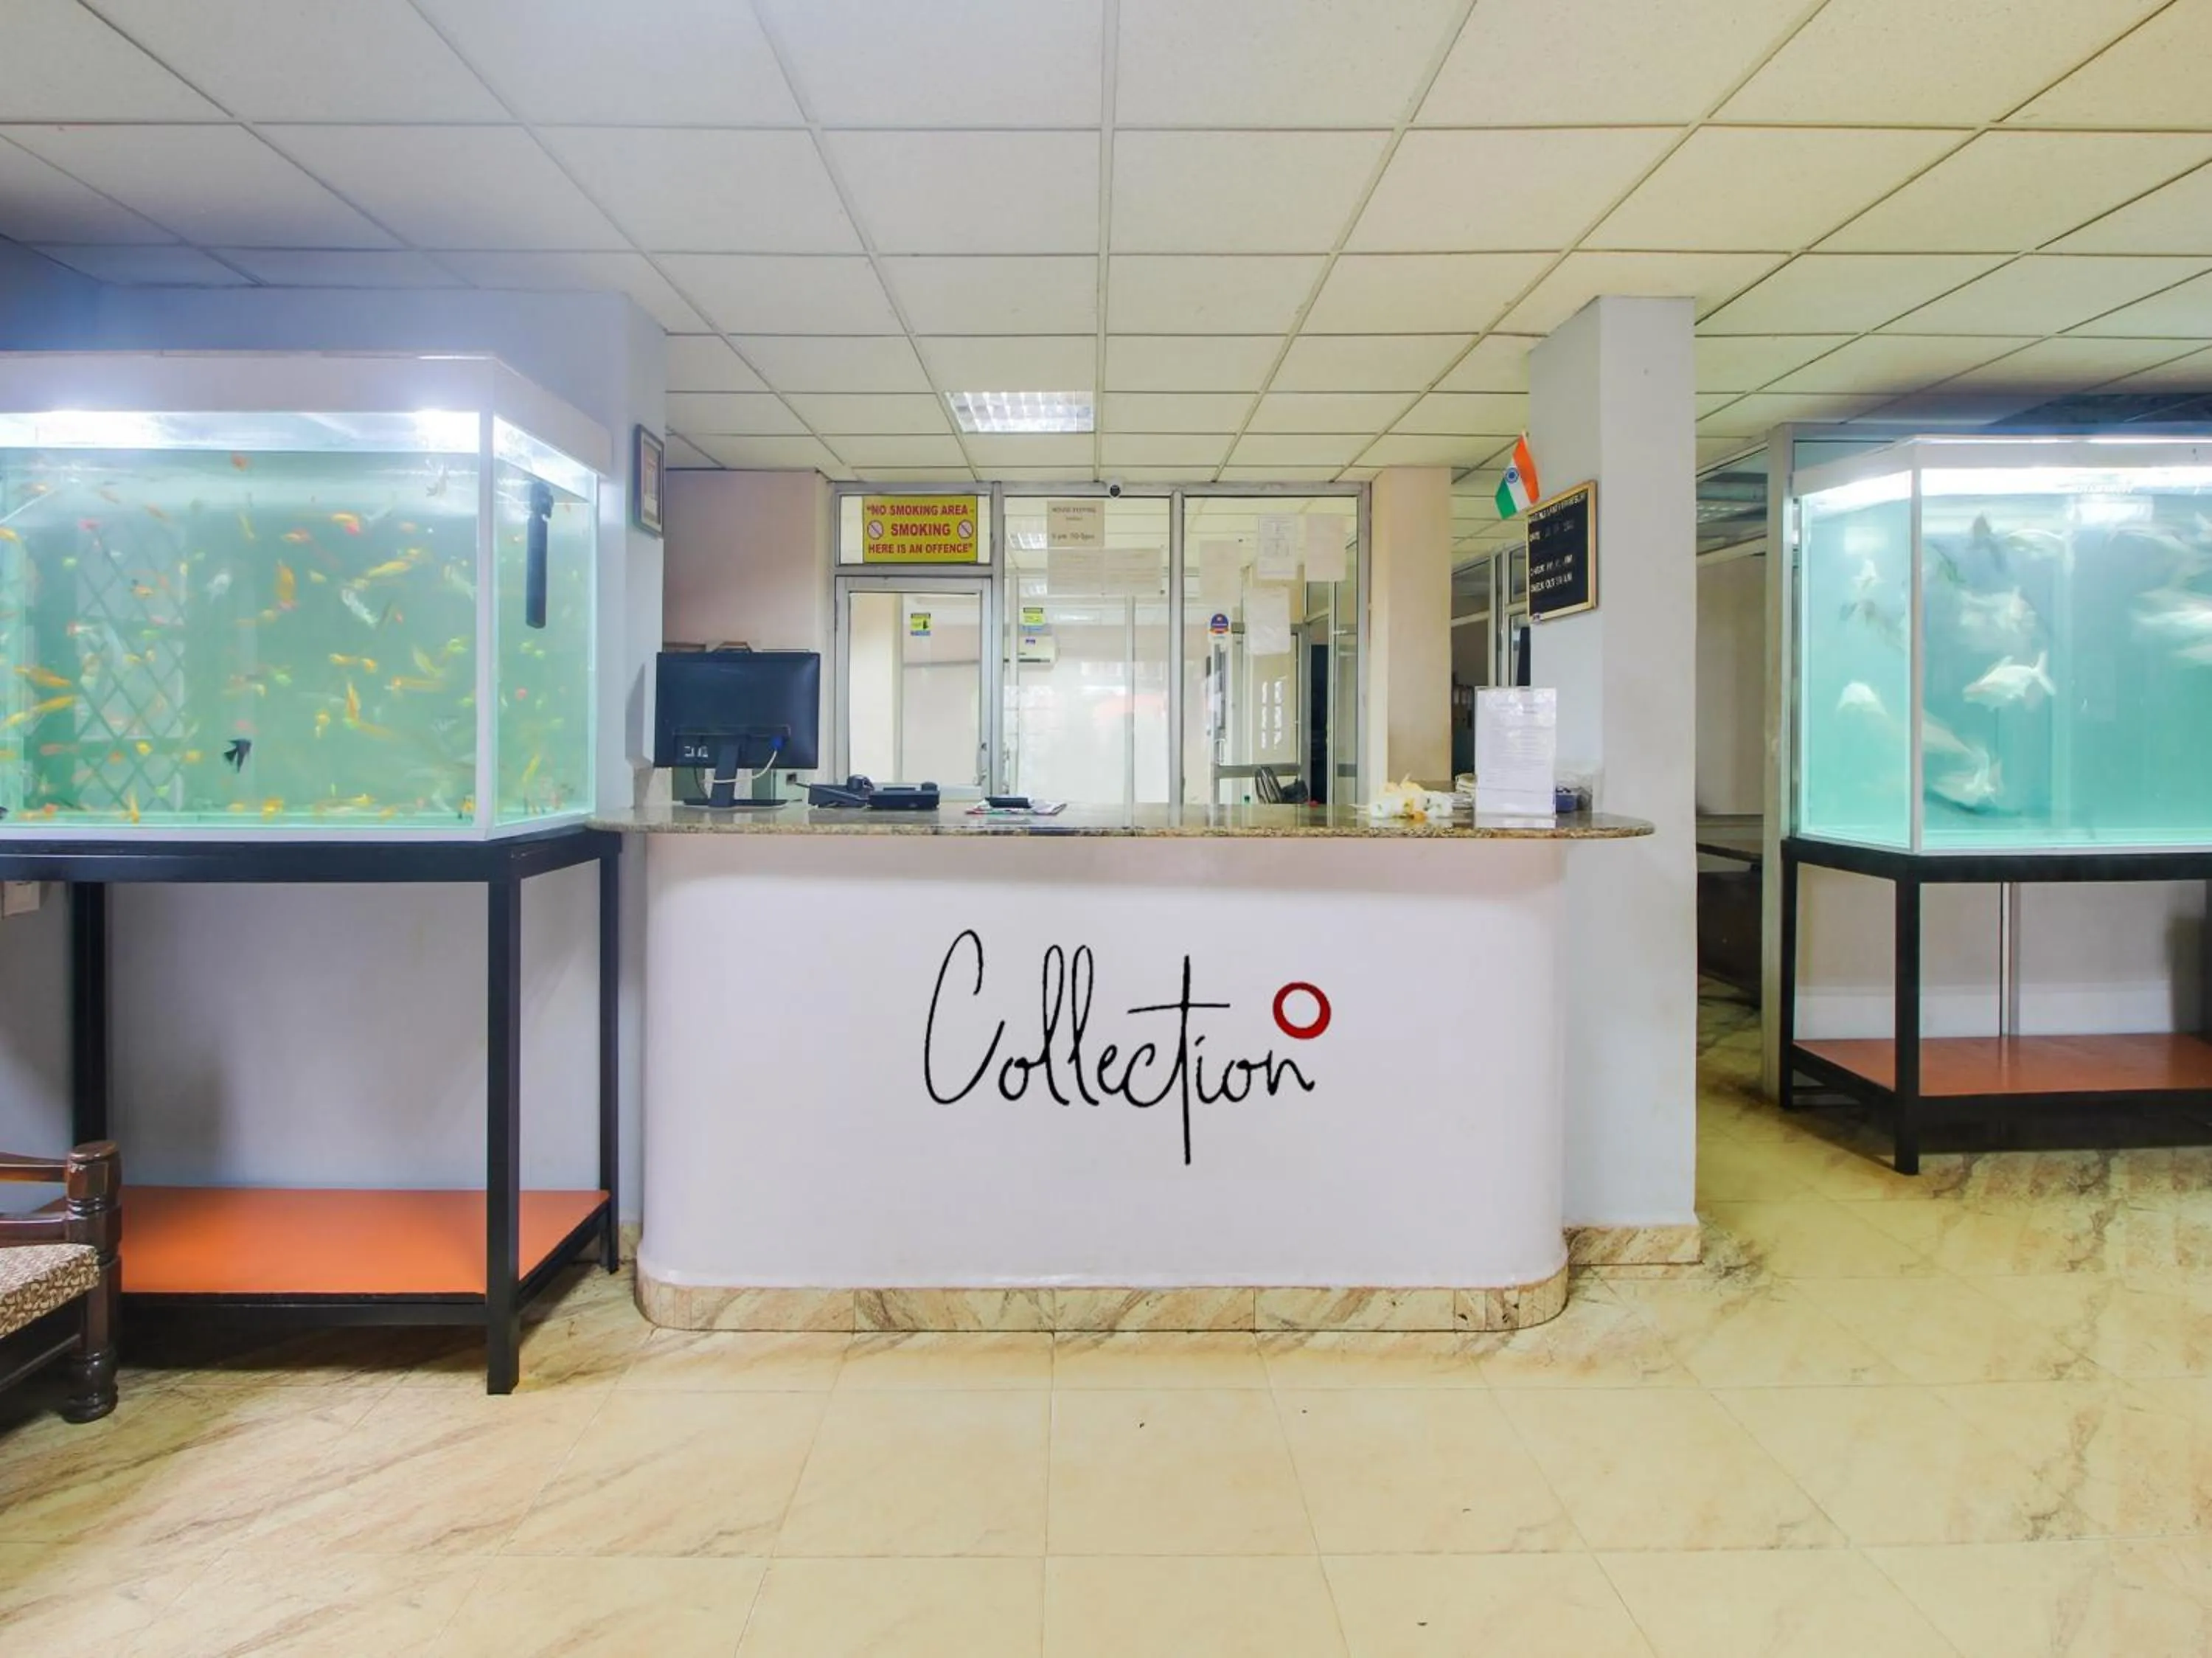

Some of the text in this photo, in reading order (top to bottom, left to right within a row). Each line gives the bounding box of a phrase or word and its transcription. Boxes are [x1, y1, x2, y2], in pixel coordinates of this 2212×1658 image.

[889, 504, 939, 516] SMOKING
[940, 504, 968, 516] AREA
[891, 523, 951, 537] SMOKING
[868, 544, 894, 554] HERE
[897, 544, 906, 554] IS
[909, 544, 922, 554] AN
[924, 929, 1315, 1165] Collection
